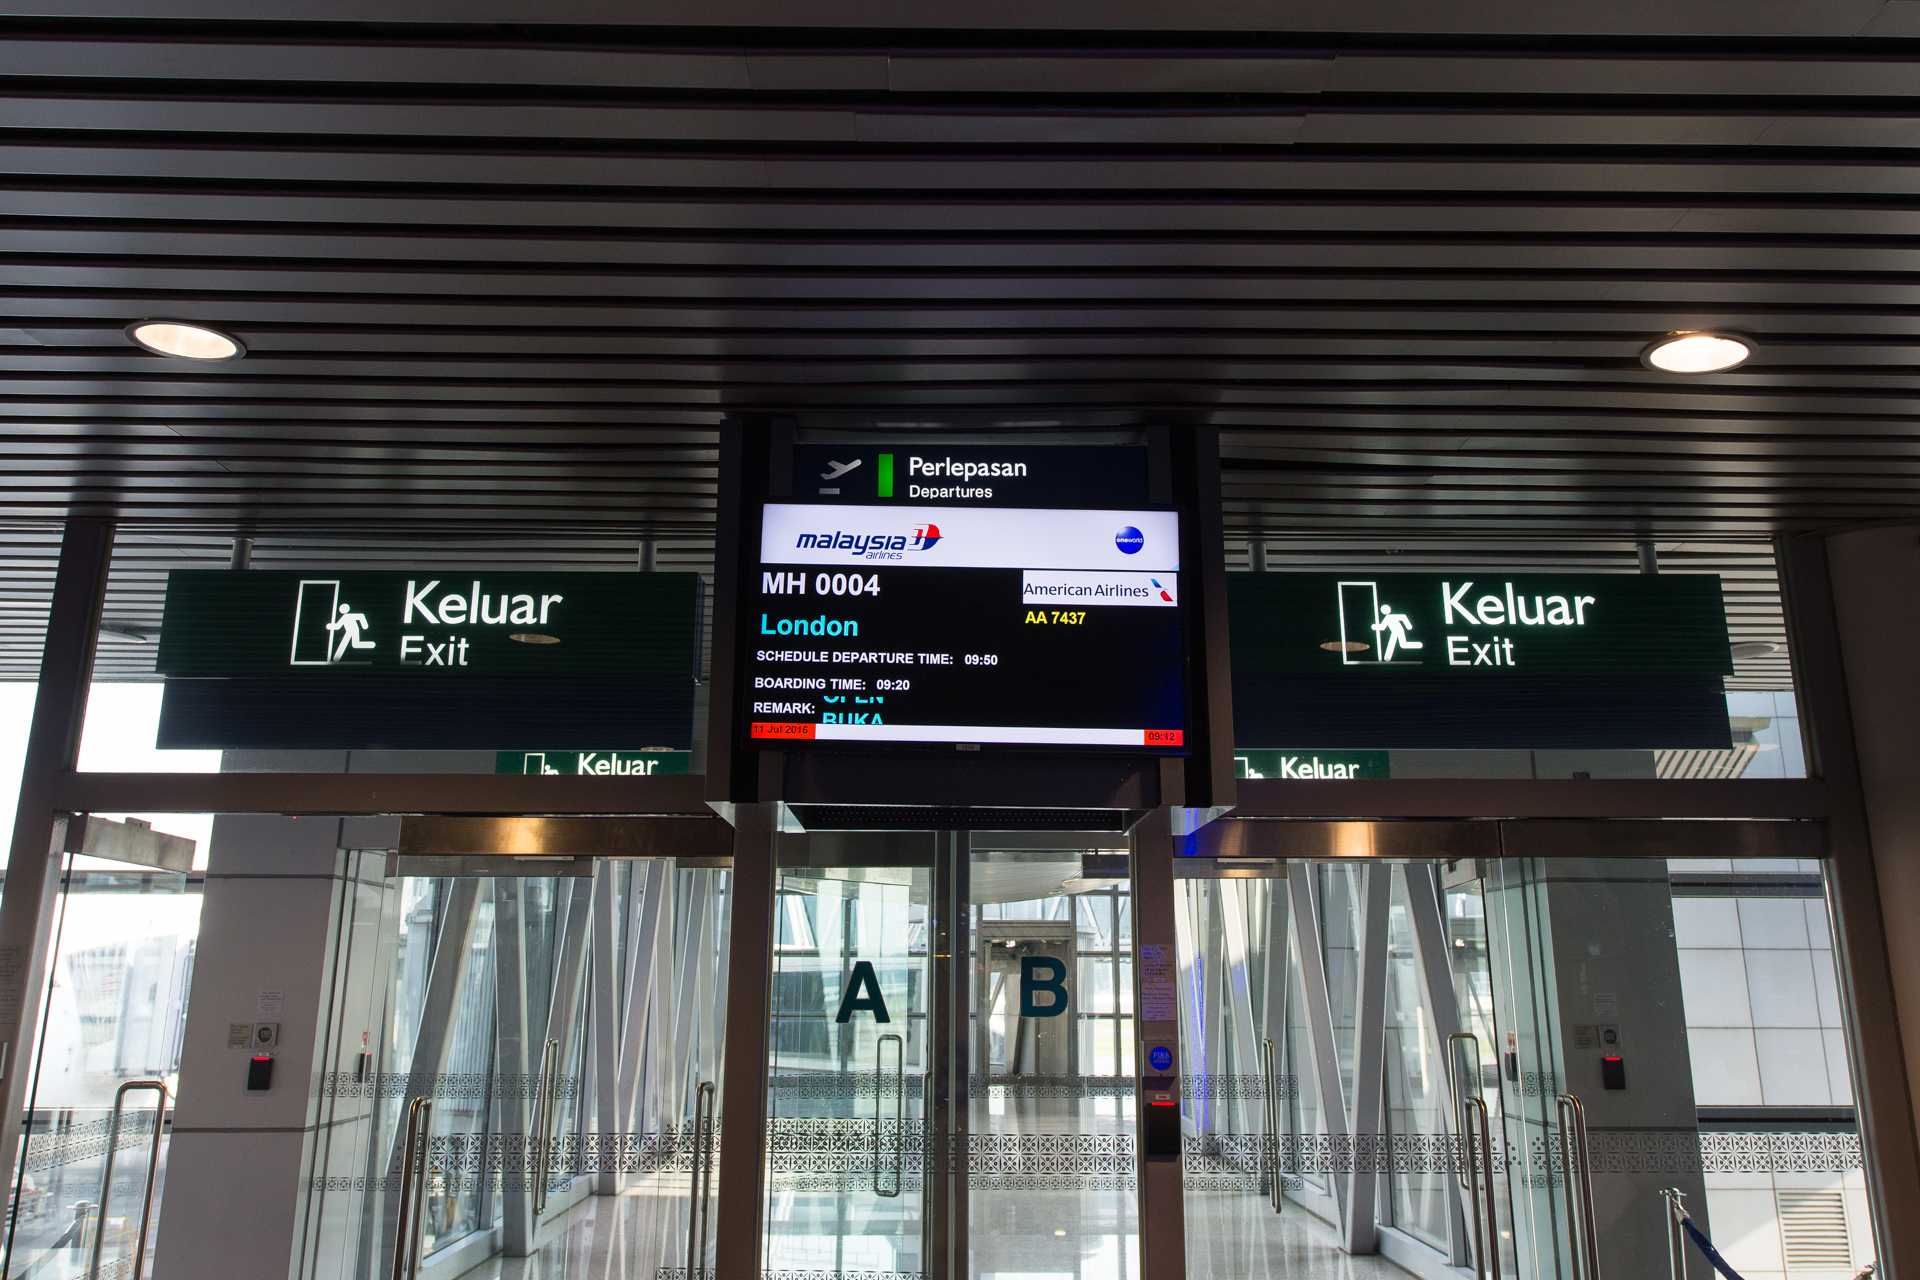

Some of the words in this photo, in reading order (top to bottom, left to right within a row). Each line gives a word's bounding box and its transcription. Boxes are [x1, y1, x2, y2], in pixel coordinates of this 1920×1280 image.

[909, 456, 1027, 482] Perlepasan
[909, 484, 993, 499] Departures
[796, 531, 907, 556] malaysia
[865, 551, 903, 560] airlines
[762, 571, 806, 595] MH
[815, 572, 881, 597] 0004
[1023, 583, 1092, 597] American
[1094, 584, 1149, 598] Airlines
[403, 580, 564, 625] Keluar
[1441, 581, 1596, 626] Keluar
[761, 614, 859, 637] London
[1025, 611, 1048, 625] AA
[1051, 611, 1086, 625] 7437
[400, 635, 470, 666] Exit
[756, 650, 829, 663] SCHEDULE
[832, 652, 914, 665] DEPARTURE
[917, 653, 954, 665] TIME:
[964, 654, 999, 666] 09:50
[1446, 635, 1516, 666] Exit
[754, 677, 826, 690] BOARDING
[830, 678, 866, 691] TIME:
[876, 680, 911, 691] 09:20
[753, 702, 816, 715] REMARK:
[822, 712, 884, 725] BUKA
[753, 725, 764, 734] 11
[767, 725, 783, 734] Jul
[785, 725, 808, 734] 2016
[1149, 732, 1175, 741] 09:12
[577, 754, 659, 776] Keluar
[1280, 756, 1360, 779] Keluar
[835, 961, 891, 1023] A
[1020, 956, 1068, 1017] B
